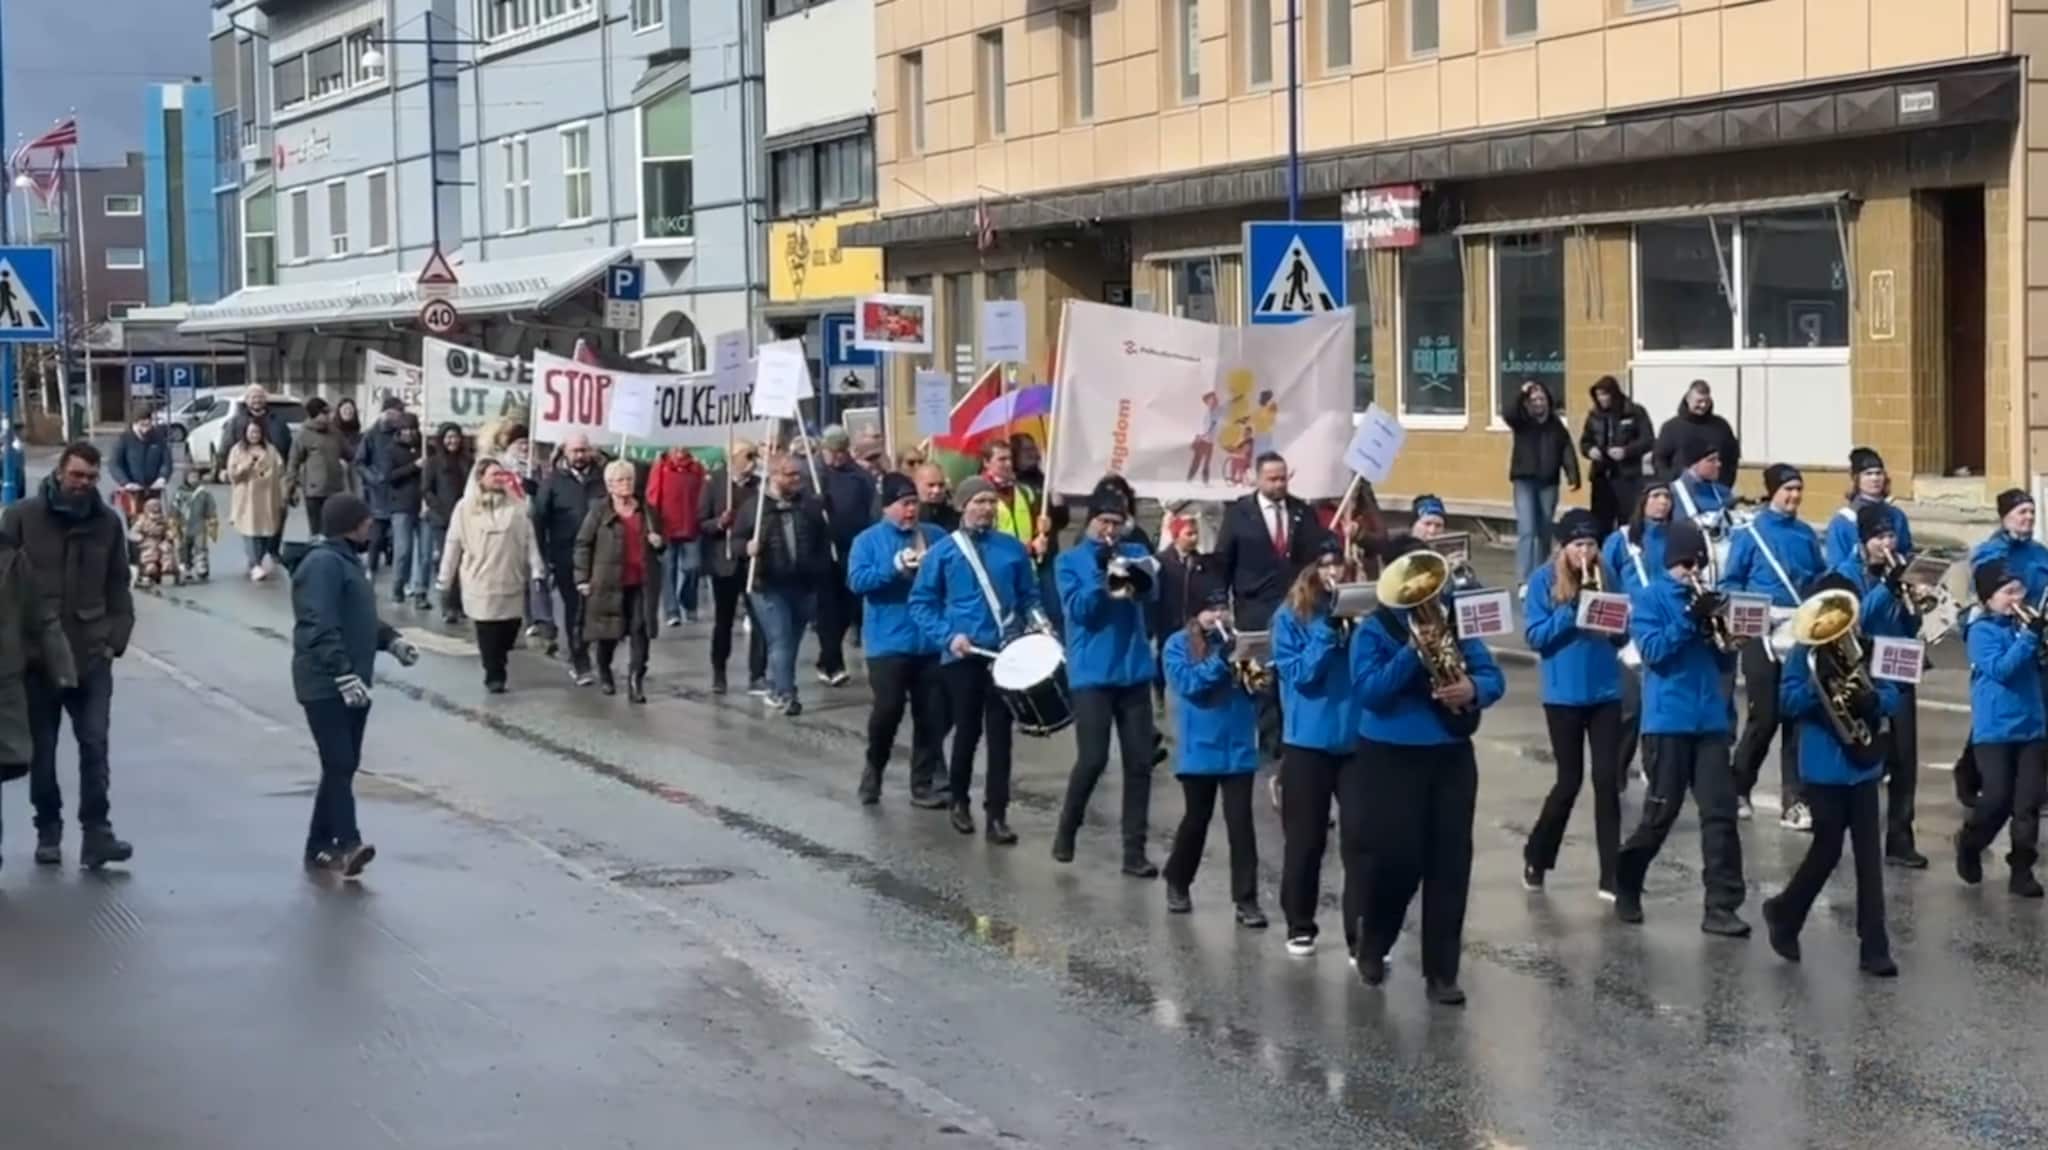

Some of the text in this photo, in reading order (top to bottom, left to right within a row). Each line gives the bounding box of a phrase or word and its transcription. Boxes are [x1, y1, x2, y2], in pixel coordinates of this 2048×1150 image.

[615, 269, 634, 296] P
[428, 309, 453, 326] 40
[134, 366, 148, 382] P
[173, 367, 187, 385] P
[450, 386, 489, 416] UT
[543, 369, 613, 426] STOP
[1110, 398, 1132, 473] ngdom
